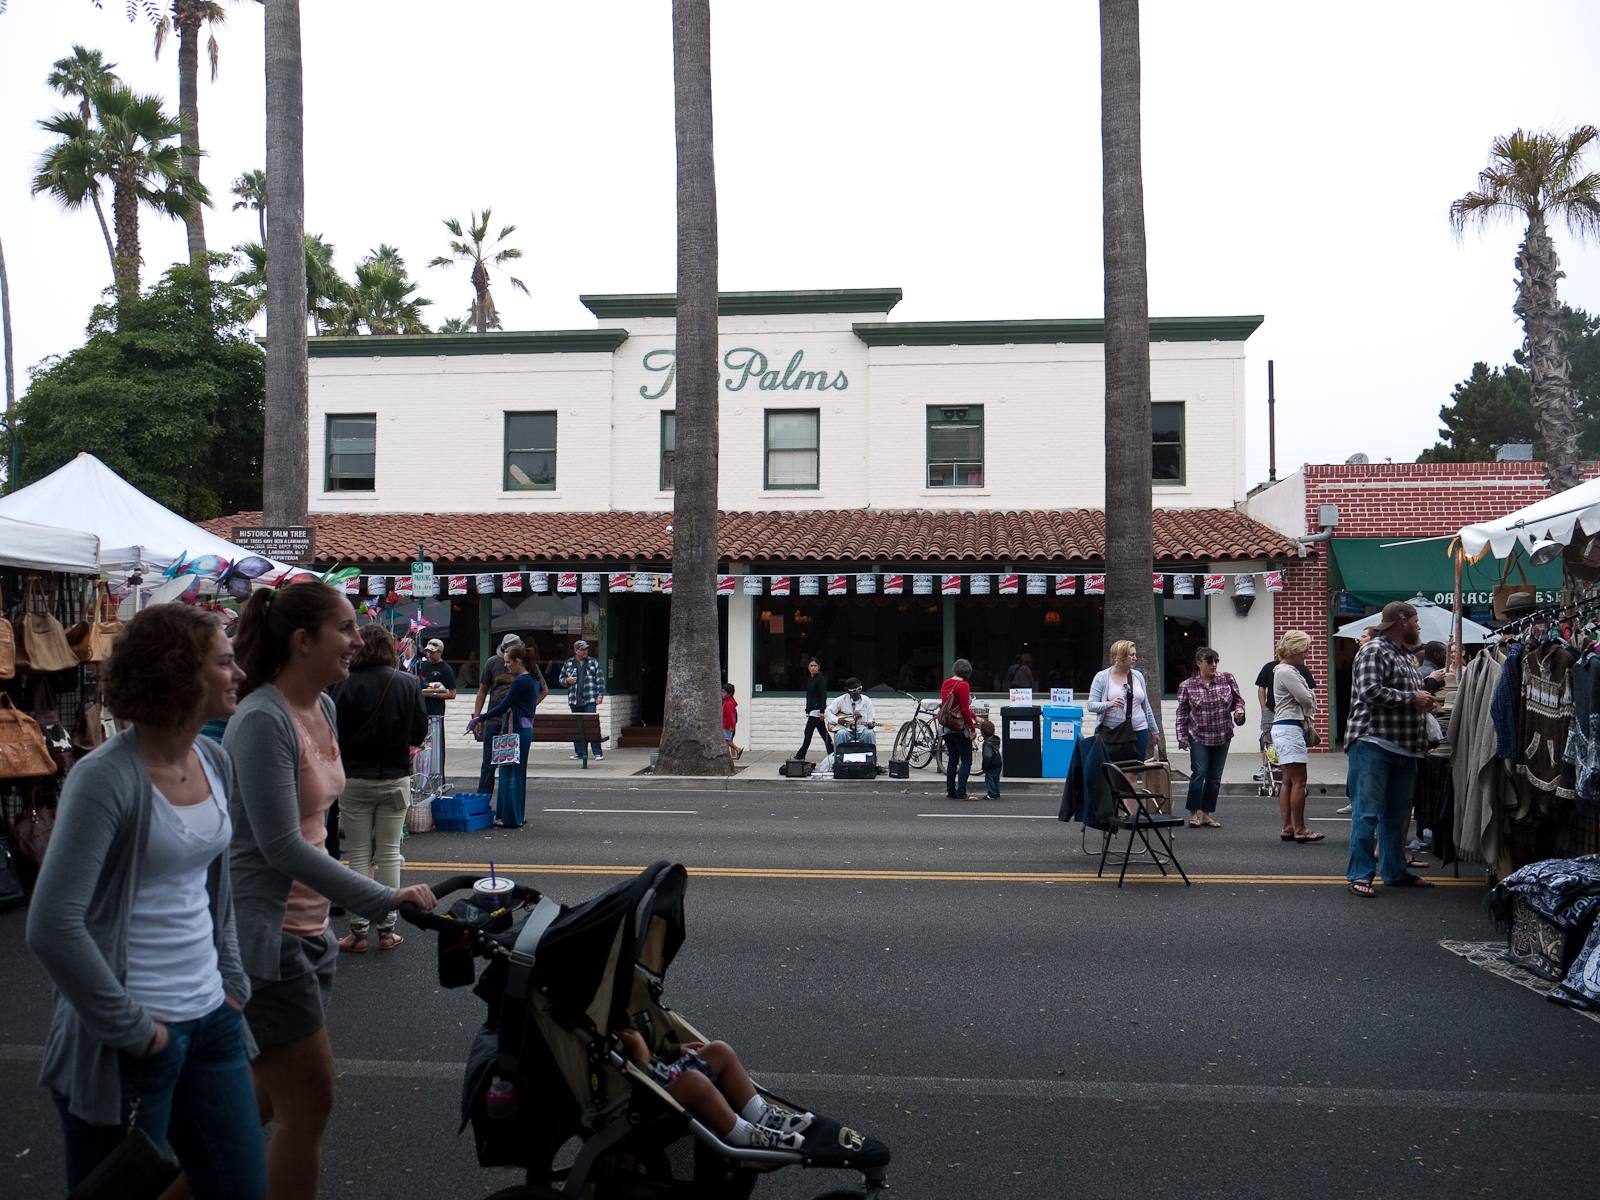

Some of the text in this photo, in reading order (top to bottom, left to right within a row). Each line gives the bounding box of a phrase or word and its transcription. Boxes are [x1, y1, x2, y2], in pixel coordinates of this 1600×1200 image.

[724, 347, 849, 391] Palms
[239, 530, 307, 538] HISTORIC PALM TREE
[413, 563, 423, 572] 90
